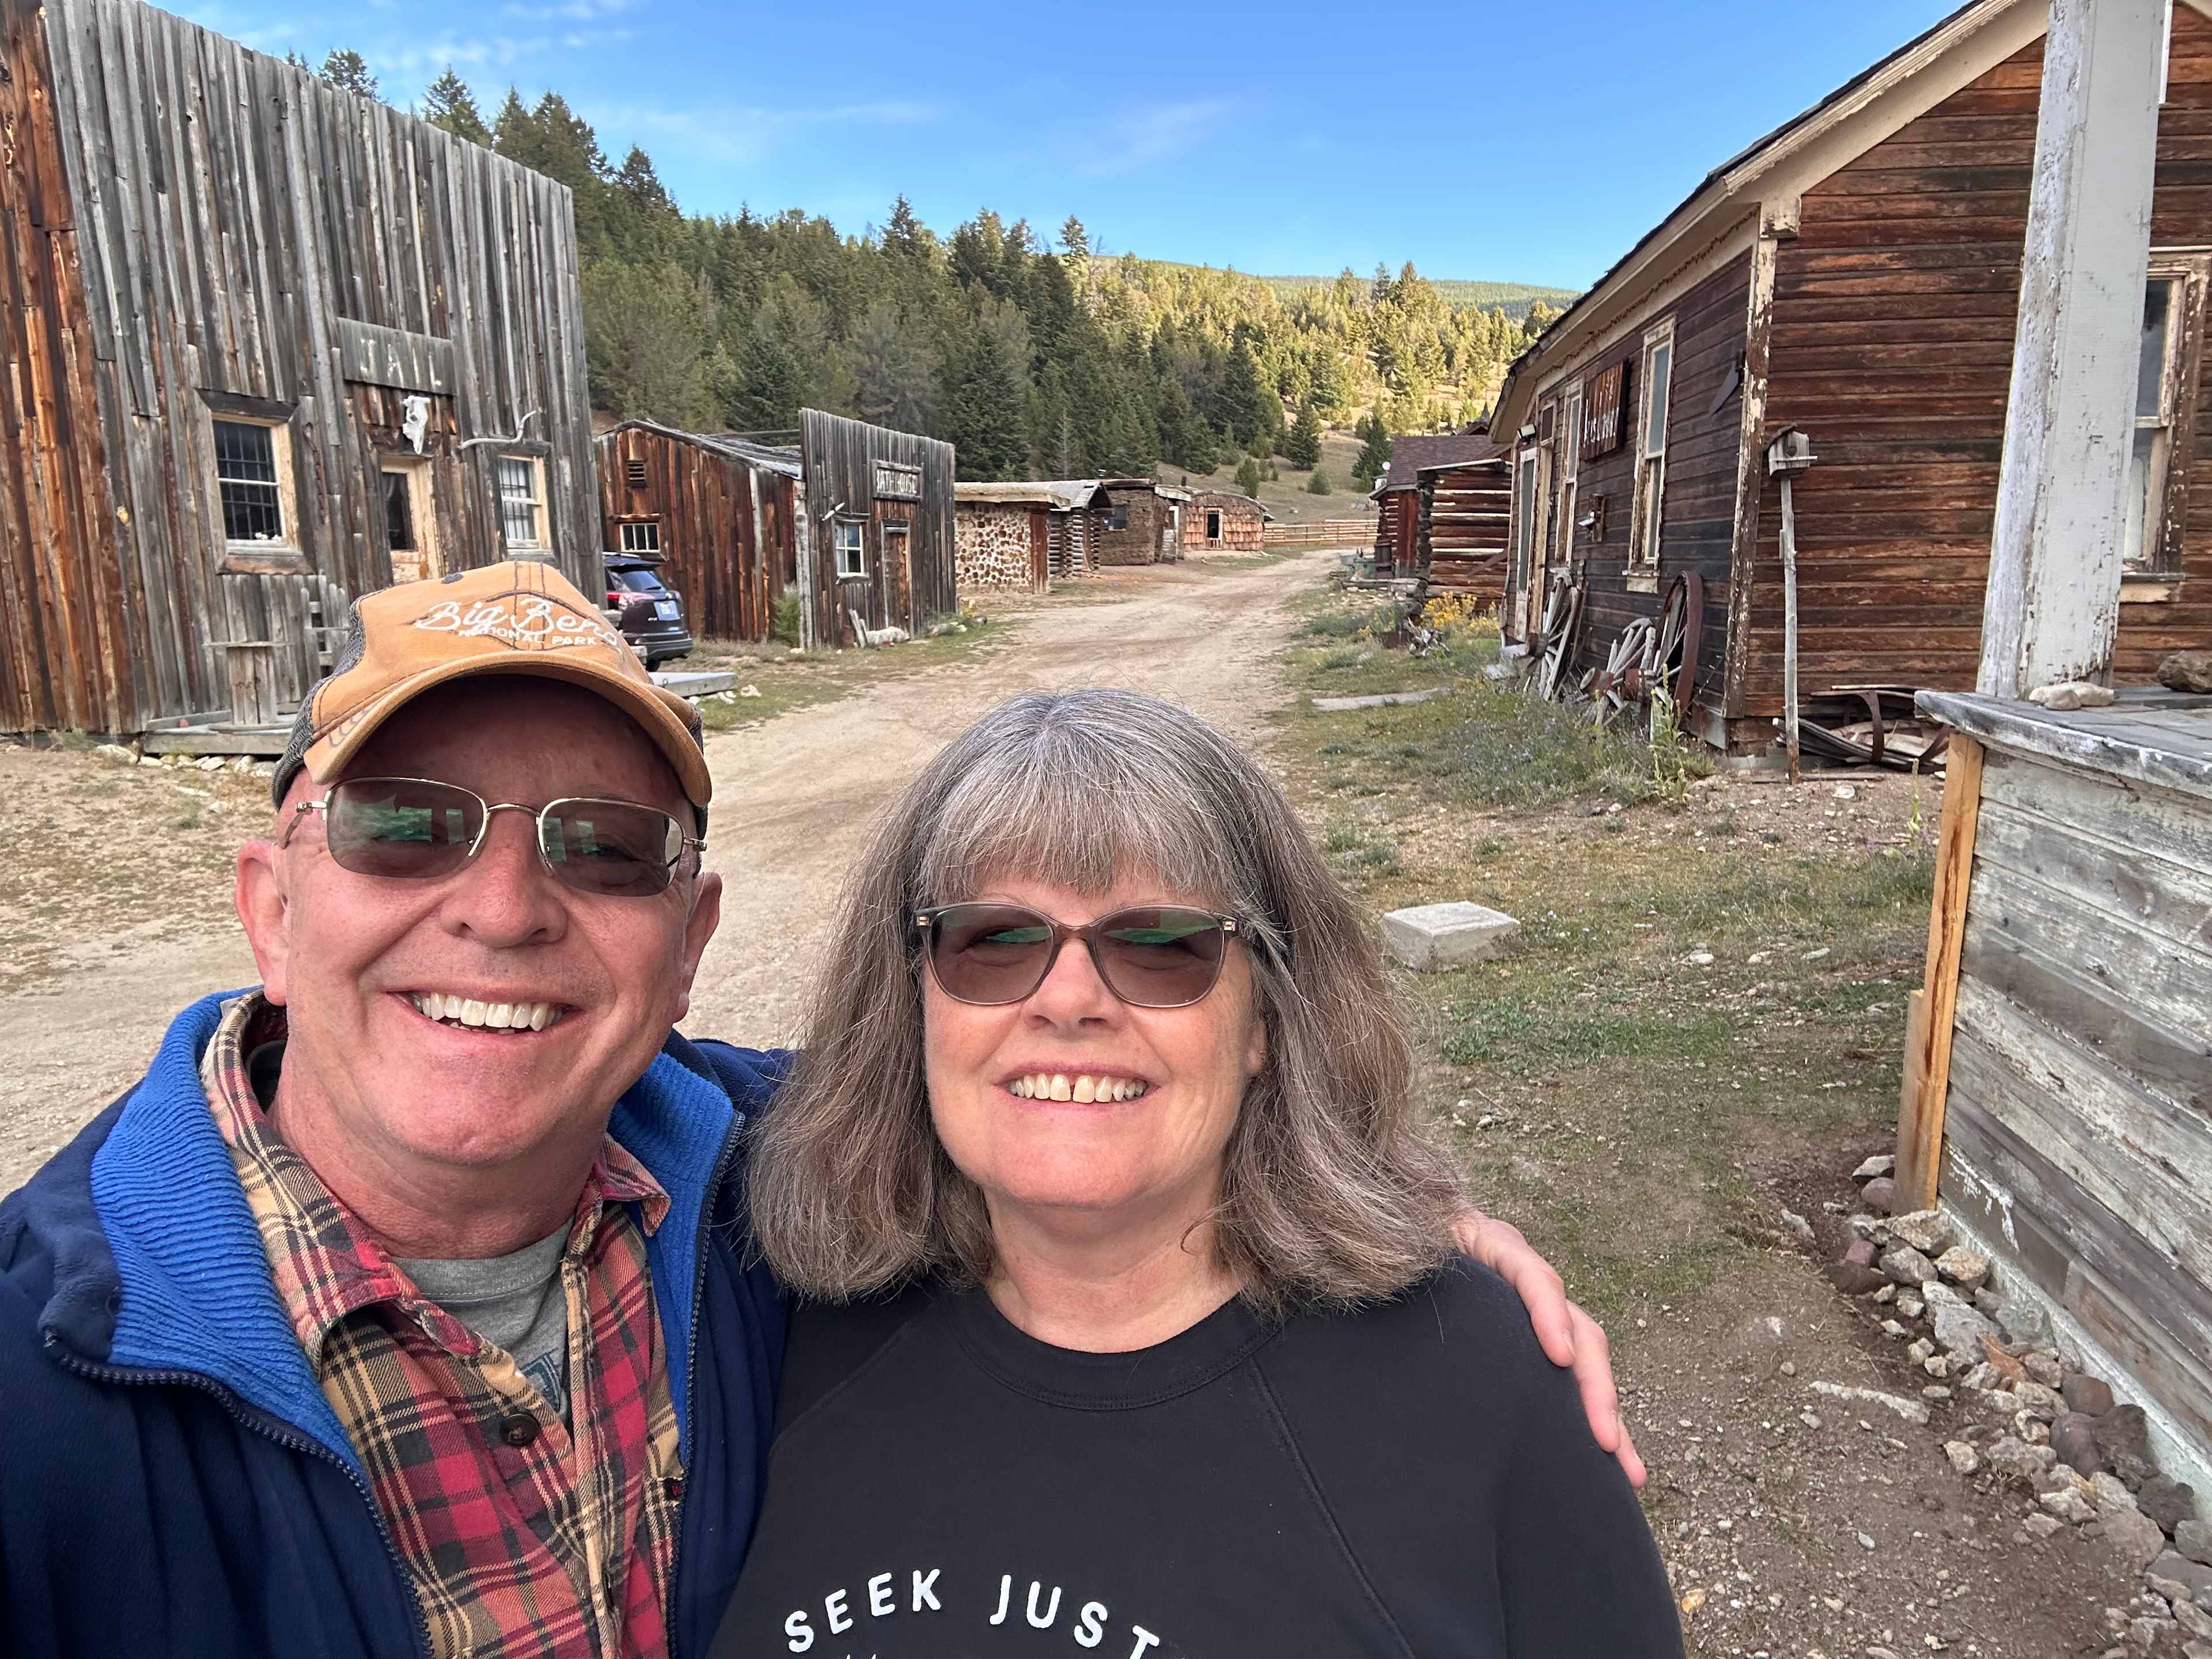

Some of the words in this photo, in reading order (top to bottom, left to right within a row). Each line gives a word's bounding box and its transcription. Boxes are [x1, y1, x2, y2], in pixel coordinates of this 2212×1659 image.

[415, 601, 508, 637] Big
[510, 598, 622, 654] Bend
[459, 627, 545, 643] NONAL
[551, 635, 598, 645] PARK
[785, 1569, 941, 1653] SEEK
